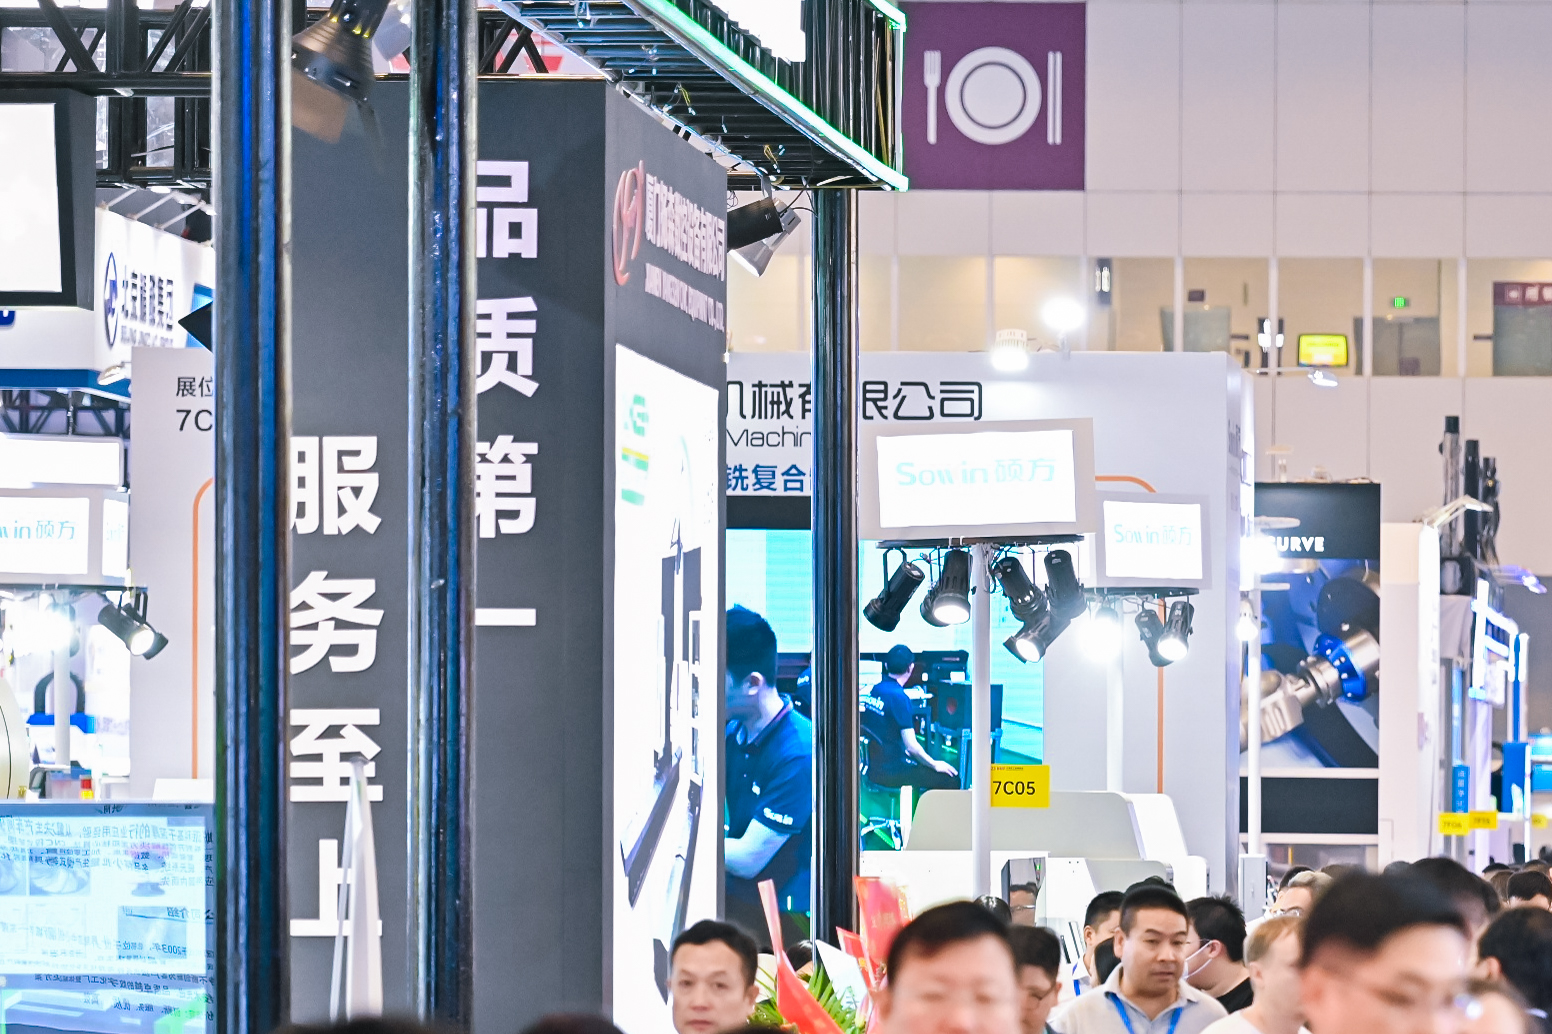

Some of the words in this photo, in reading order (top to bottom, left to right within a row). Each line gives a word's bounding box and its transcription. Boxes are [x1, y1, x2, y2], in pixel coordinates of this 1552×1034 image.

[727, 381, 982, 420] 械限公司
[727, 464, 811, 492] 铣复合
[290, 435, 384, 937] 服务至上
[992, 781, 1036, 796] 7C05
